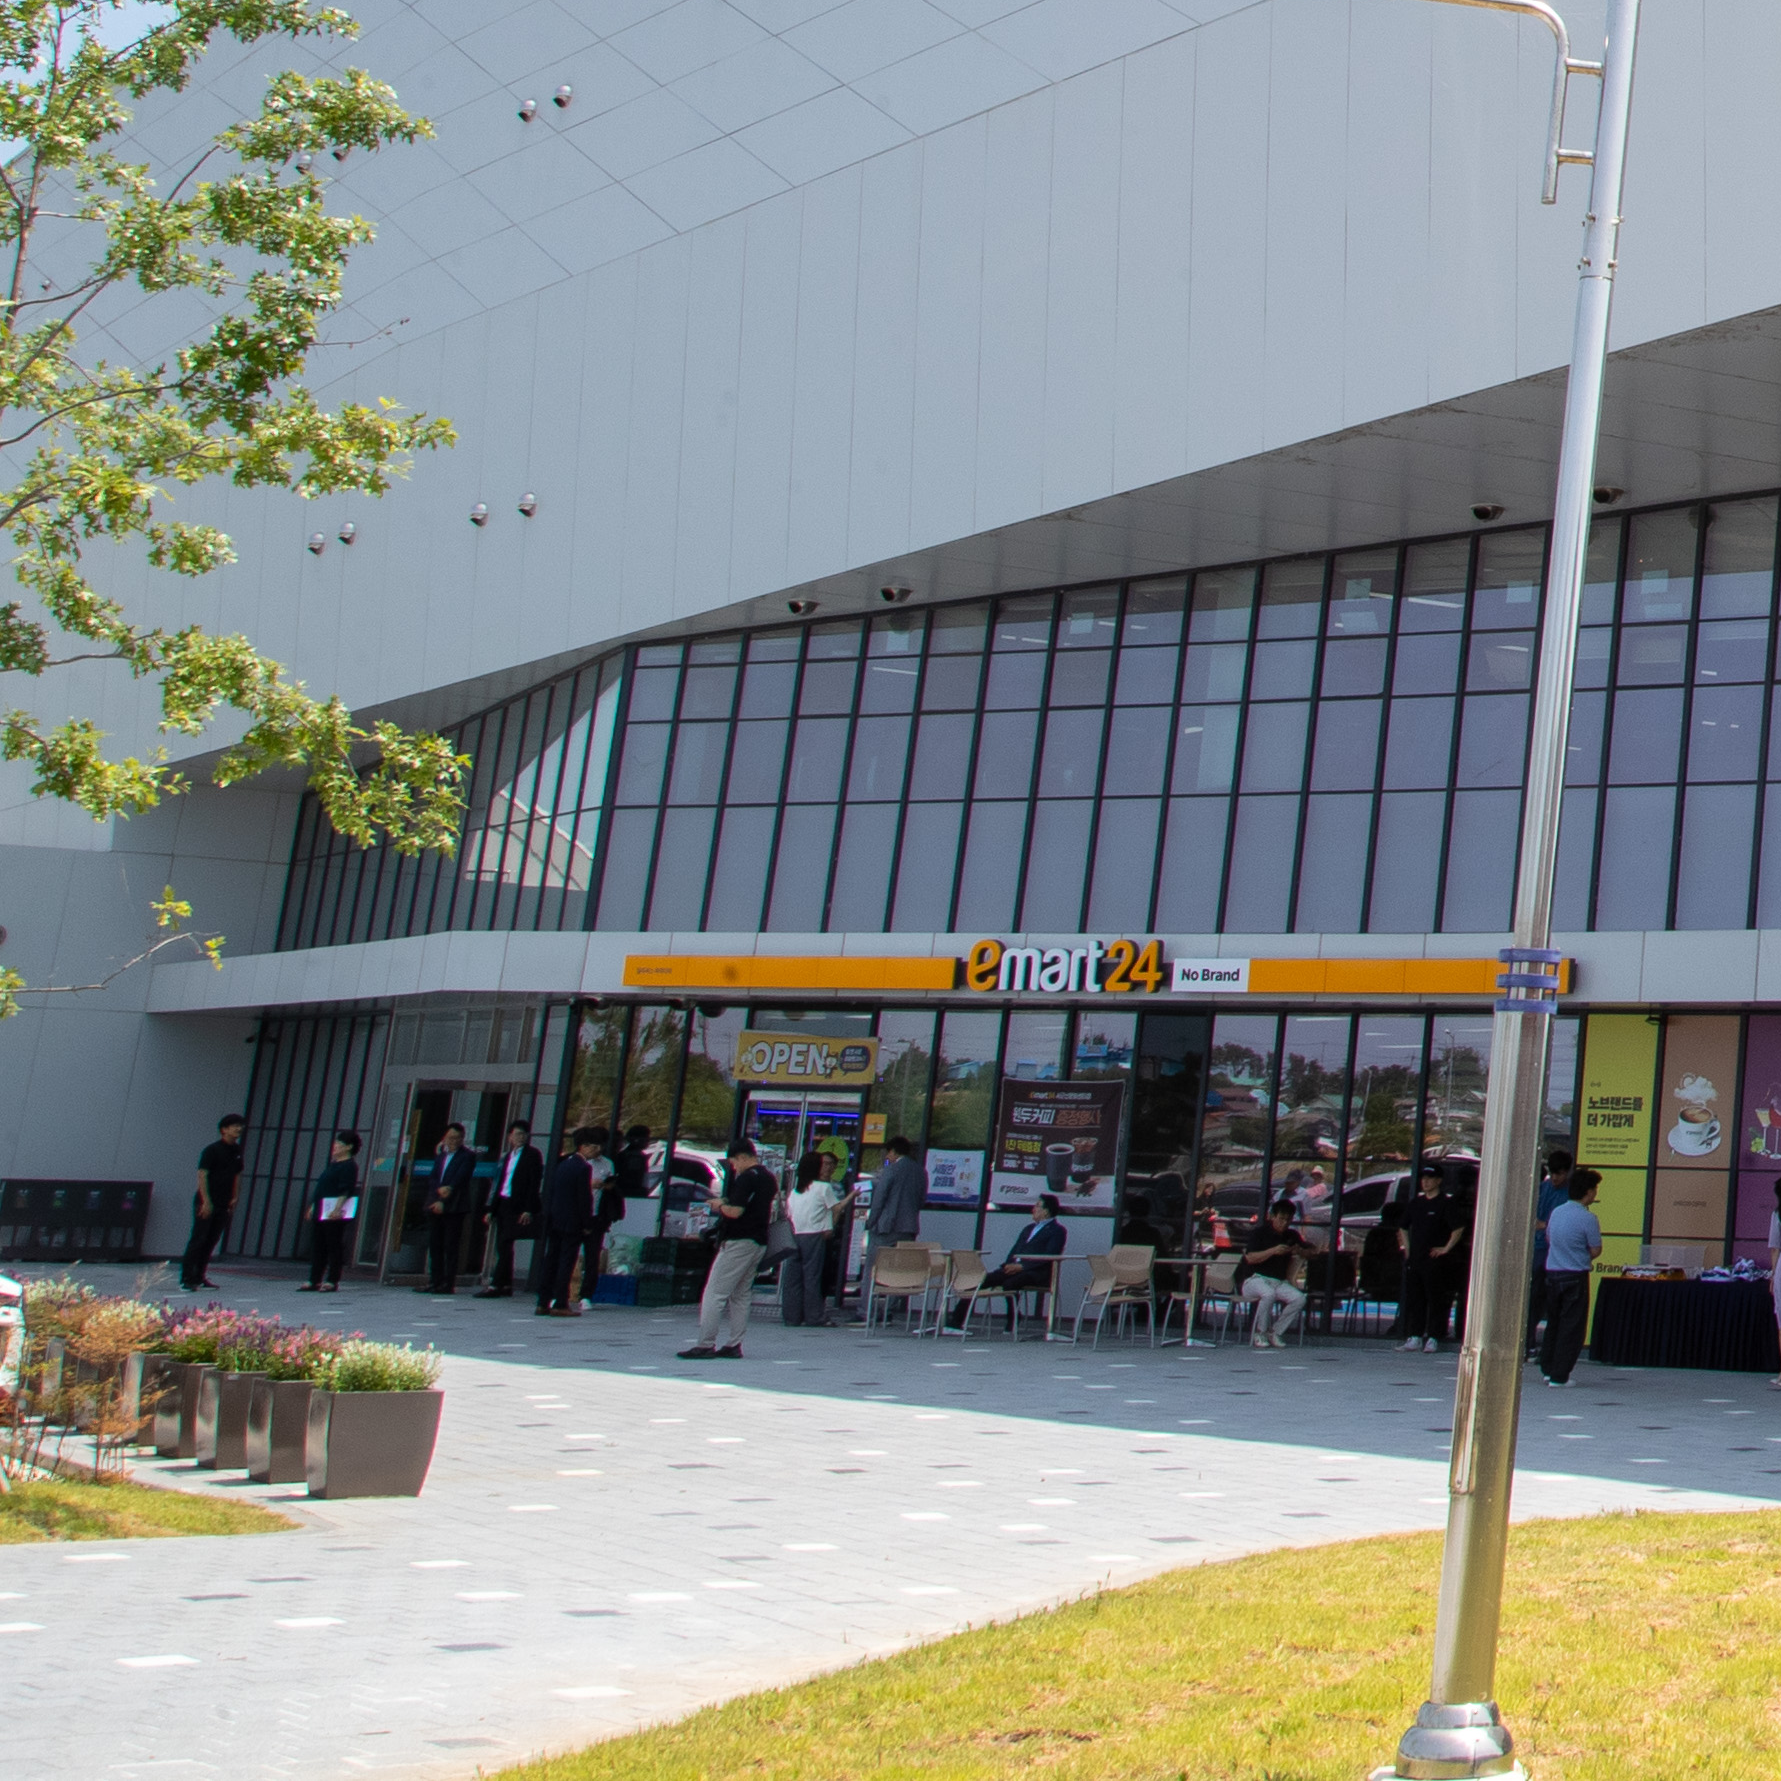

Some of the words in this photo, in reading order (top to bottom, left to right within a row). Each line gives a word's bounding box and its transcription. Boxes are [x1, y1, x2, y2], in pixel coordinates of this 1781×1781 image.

[966, 939, 1163, 993] emart24
[1181, 968, 1199, 981] No
[1201, 968, 1240, 982] Brand
[751, 1040, 831, 1075] OPEN
[1587, 1096, 1643, 1111] 노브랜드를
[1012, 1107, 1056, 1125] 원두커피
[1055, 1109, 1101, 1127] 증정행사
[1586, 1113, 1598, 1127] 더
[1600, 1113, 1635, 1128] 가깝게
